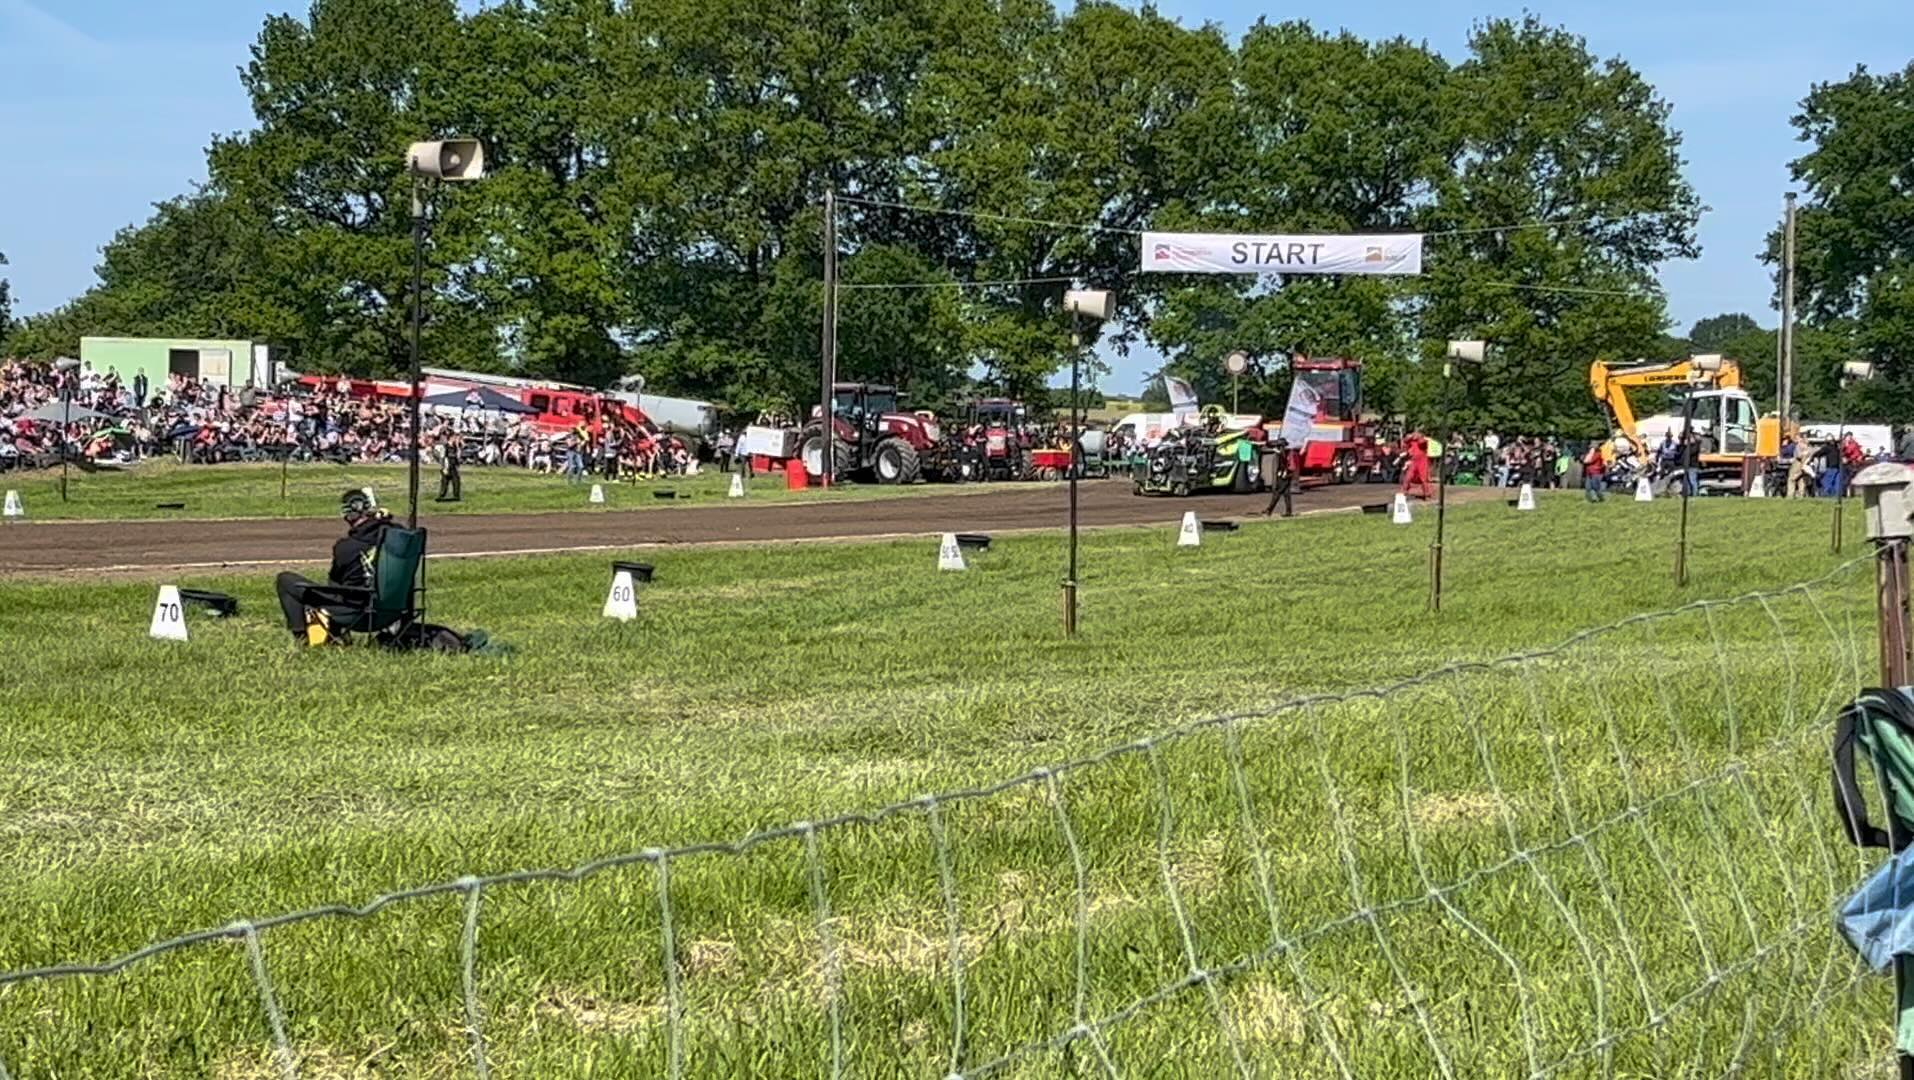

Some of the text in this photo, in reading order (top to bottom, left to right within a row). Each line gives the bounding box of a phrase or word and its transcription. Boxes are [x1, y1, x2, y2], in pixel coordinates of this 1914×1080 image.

[1231, 242, 1325, 265] START
[613, 586, 630, 602] 60
[160, 603, 179, 622] 70
